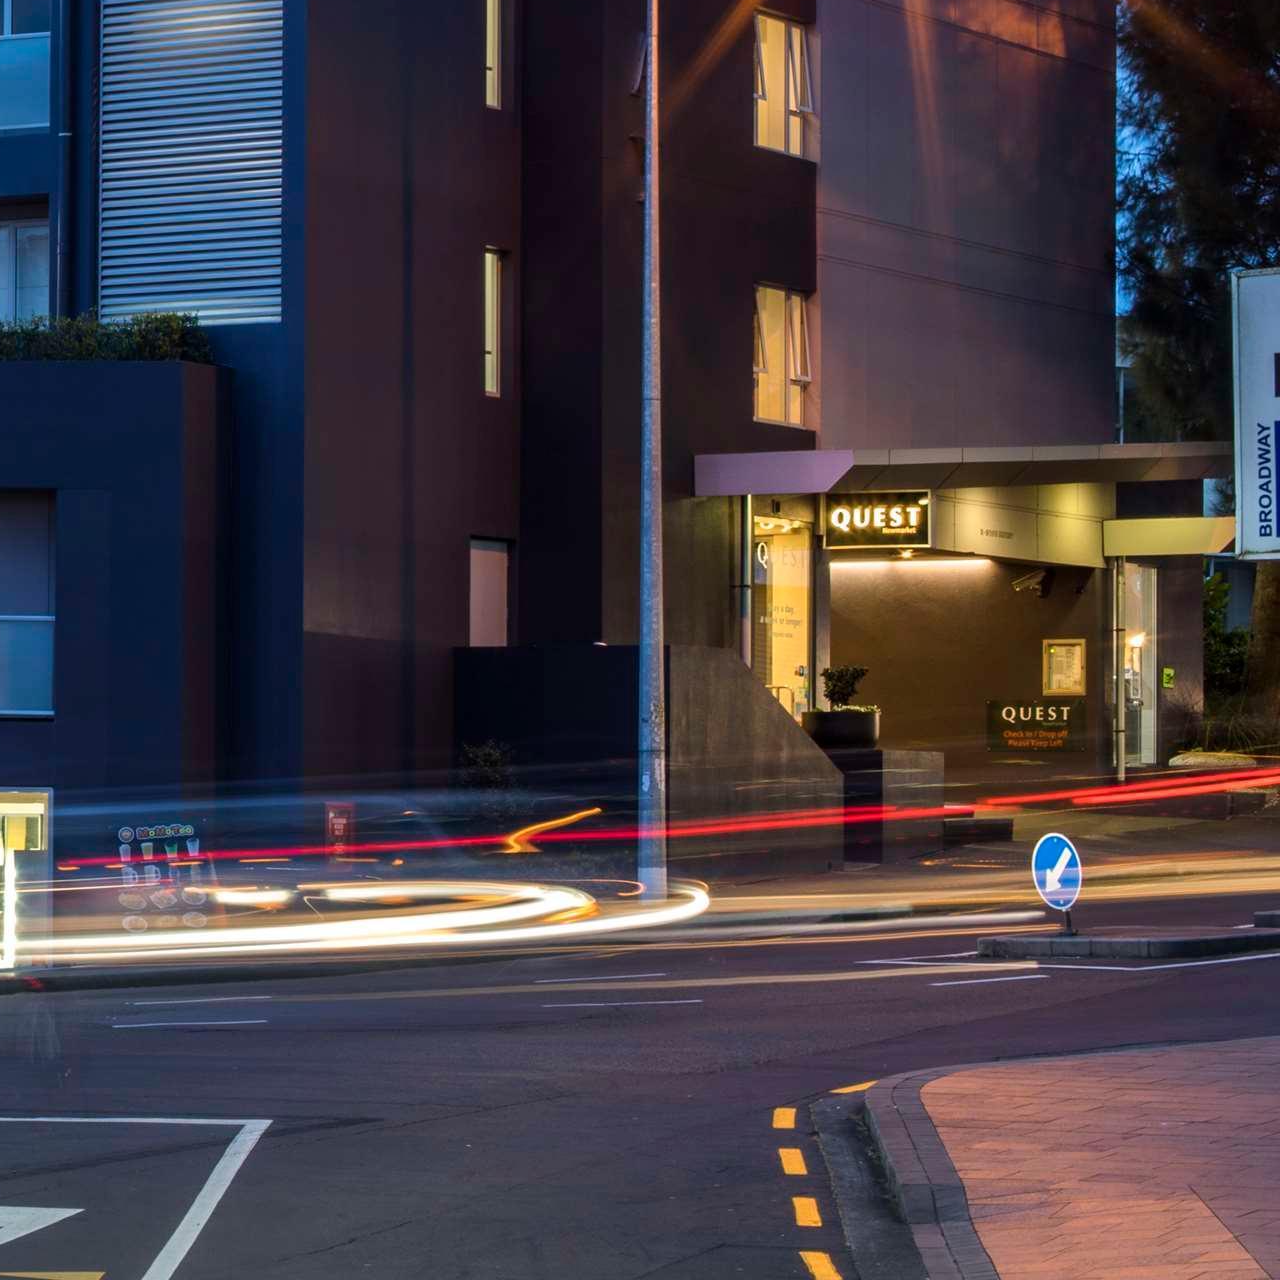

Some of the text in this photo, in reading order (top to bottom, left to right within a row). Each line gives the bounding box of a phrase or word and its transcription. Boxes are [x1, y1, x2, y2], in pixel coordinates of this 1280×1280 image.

[1257, 422, 1272, 538] BROADWAY
[831, 506, 921, 532] QUEST
[1002, 706, 1071, 724] QUEST
